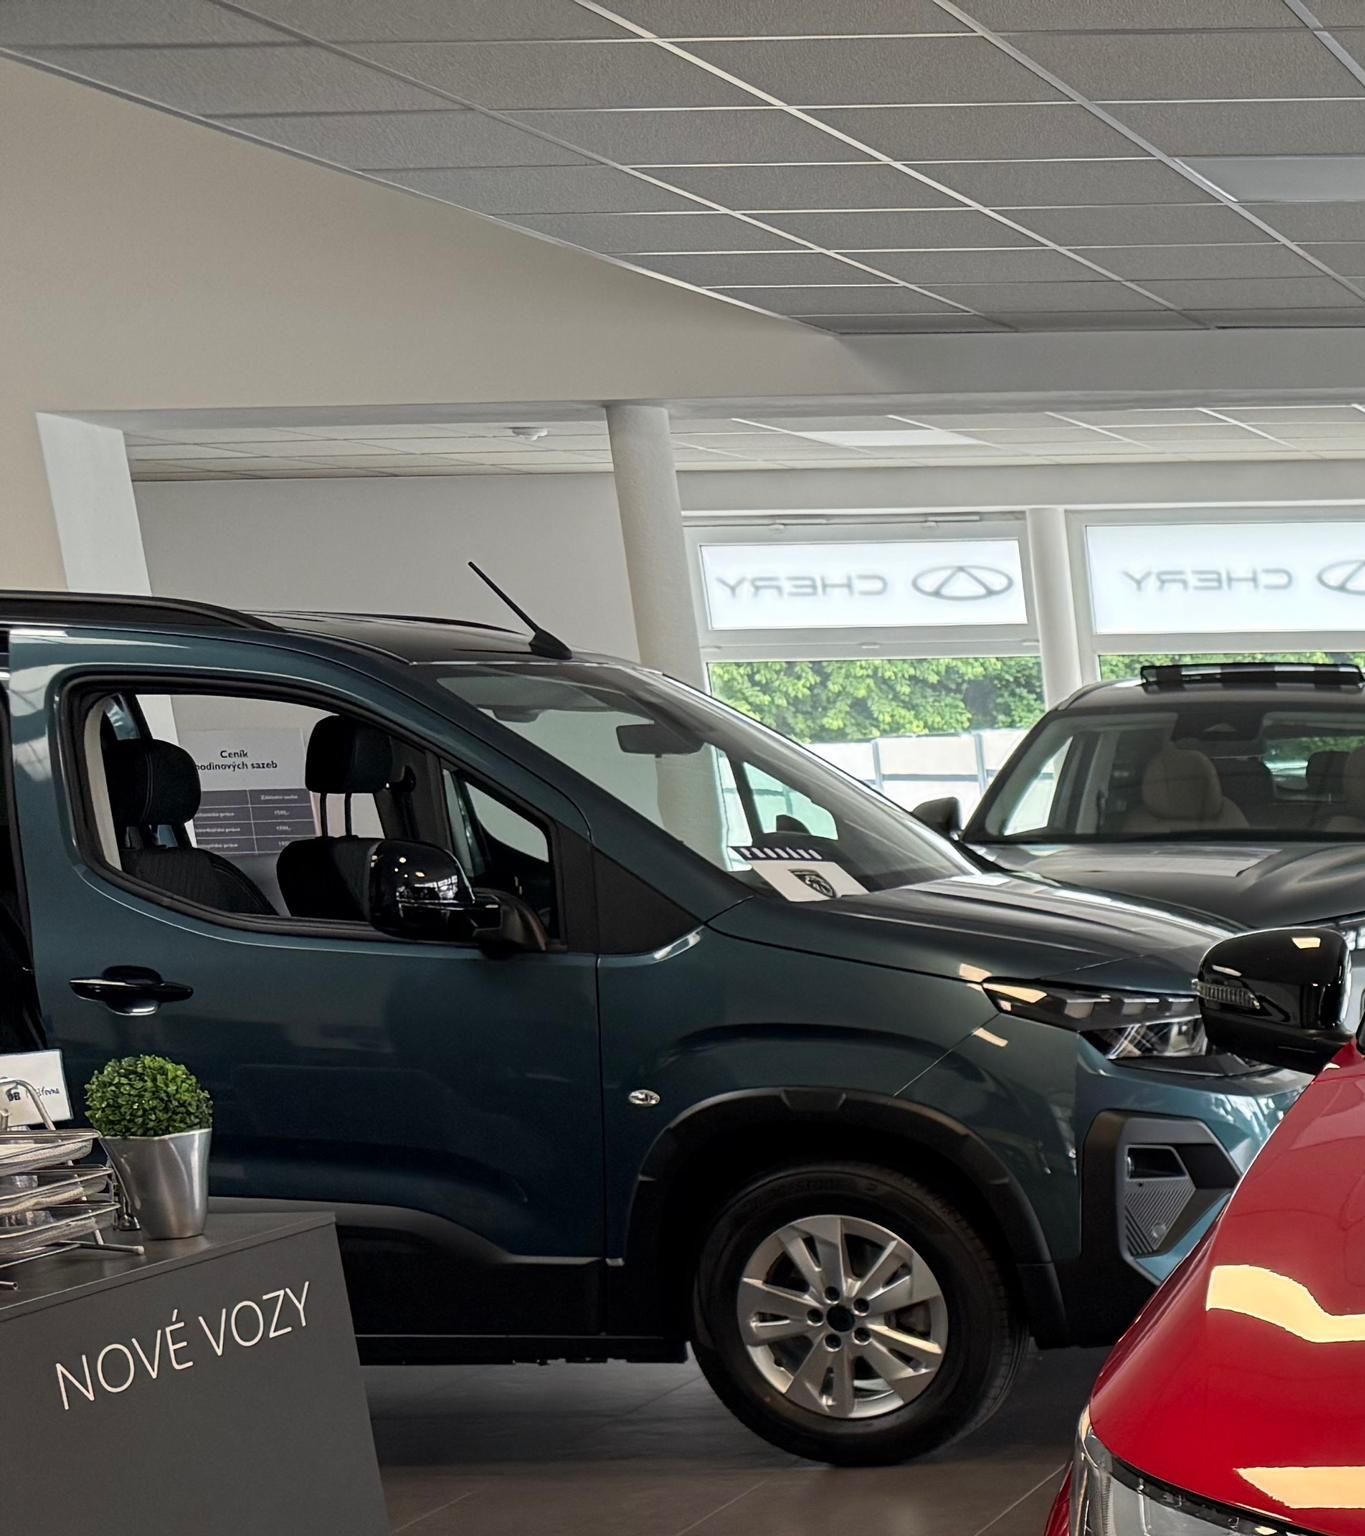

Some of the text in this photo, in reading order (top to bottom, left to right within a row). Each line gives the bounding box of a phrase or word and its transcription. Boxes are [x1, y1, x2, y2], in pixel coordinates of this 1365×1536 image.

[220, 750, 248, 759] Ceník
[56, 1281, 309, 1410] NOVÉ VOZY
